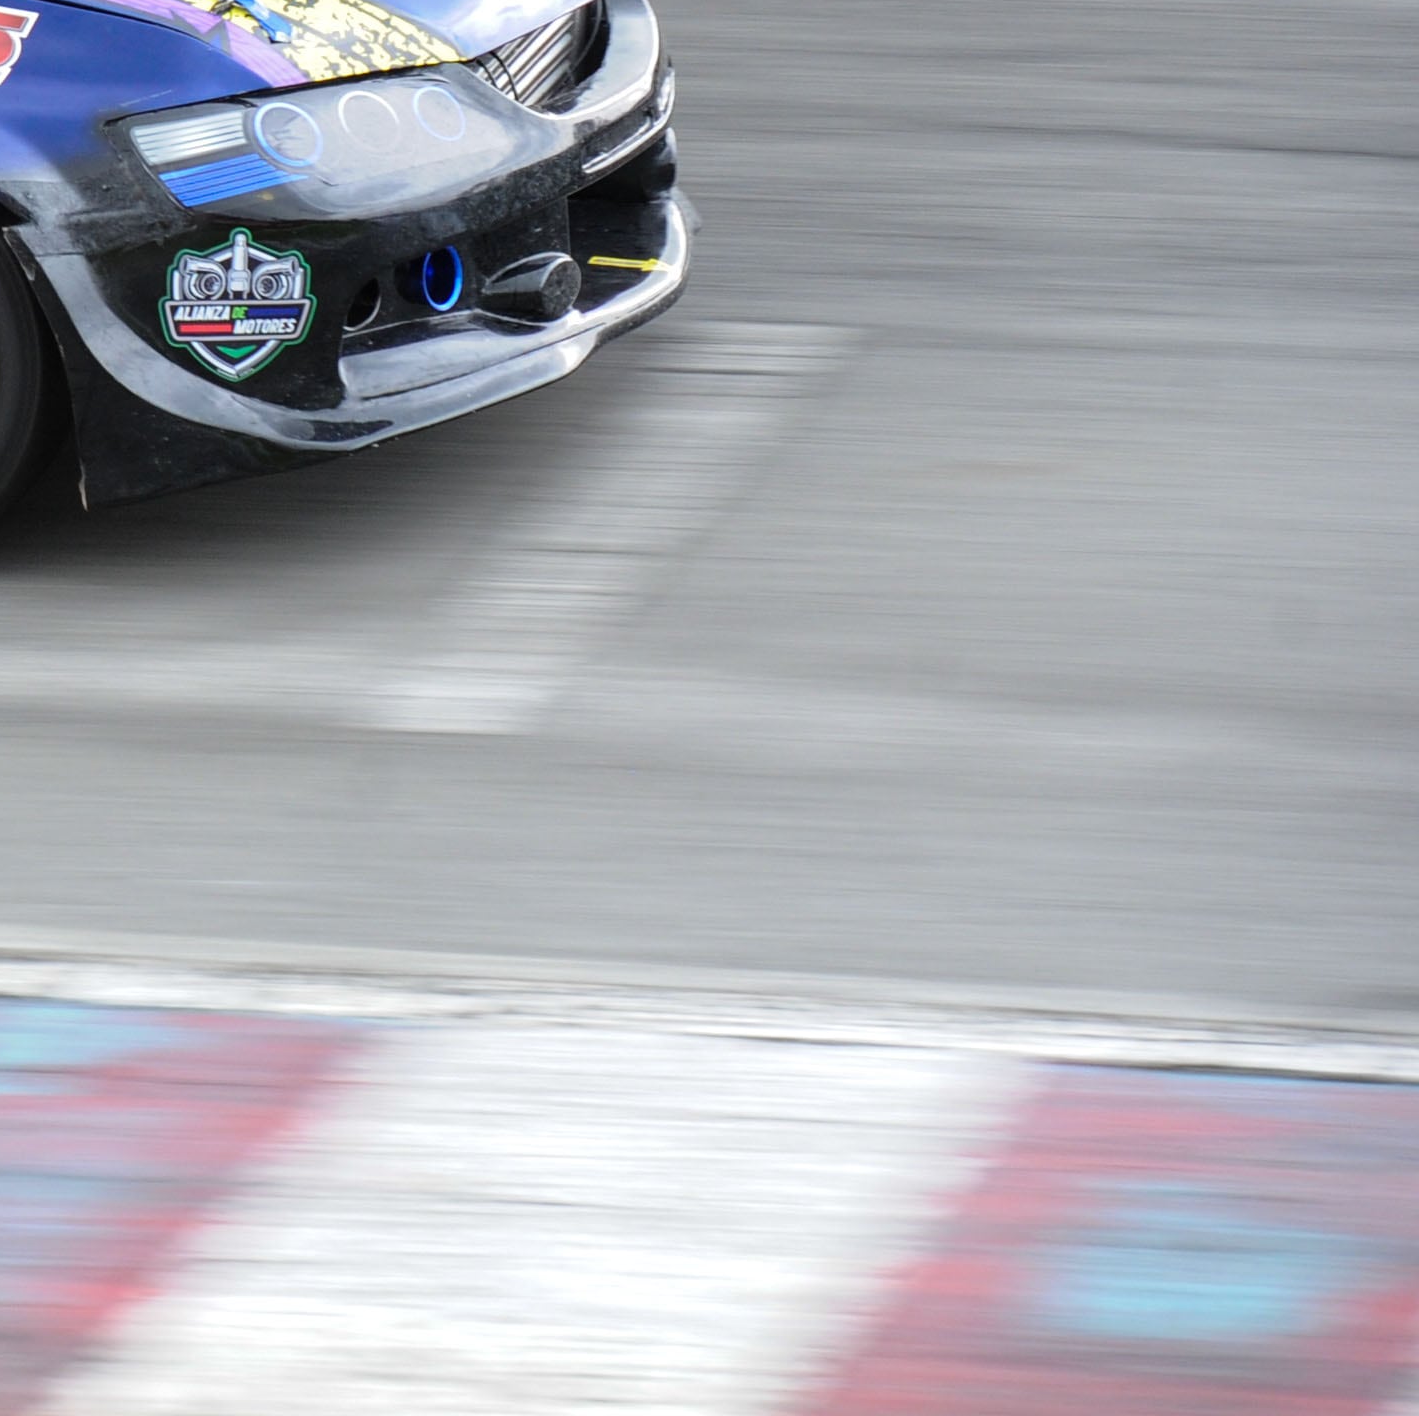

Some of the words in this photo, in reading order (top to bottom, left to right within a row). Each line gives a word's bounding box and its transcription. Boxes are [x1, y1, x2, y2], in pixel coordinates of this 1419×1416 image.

[174, 305, 231, 321] ALIANZA
[231, 306, 249, 319] DE
[232, 318, 298, 335] MOTORES
